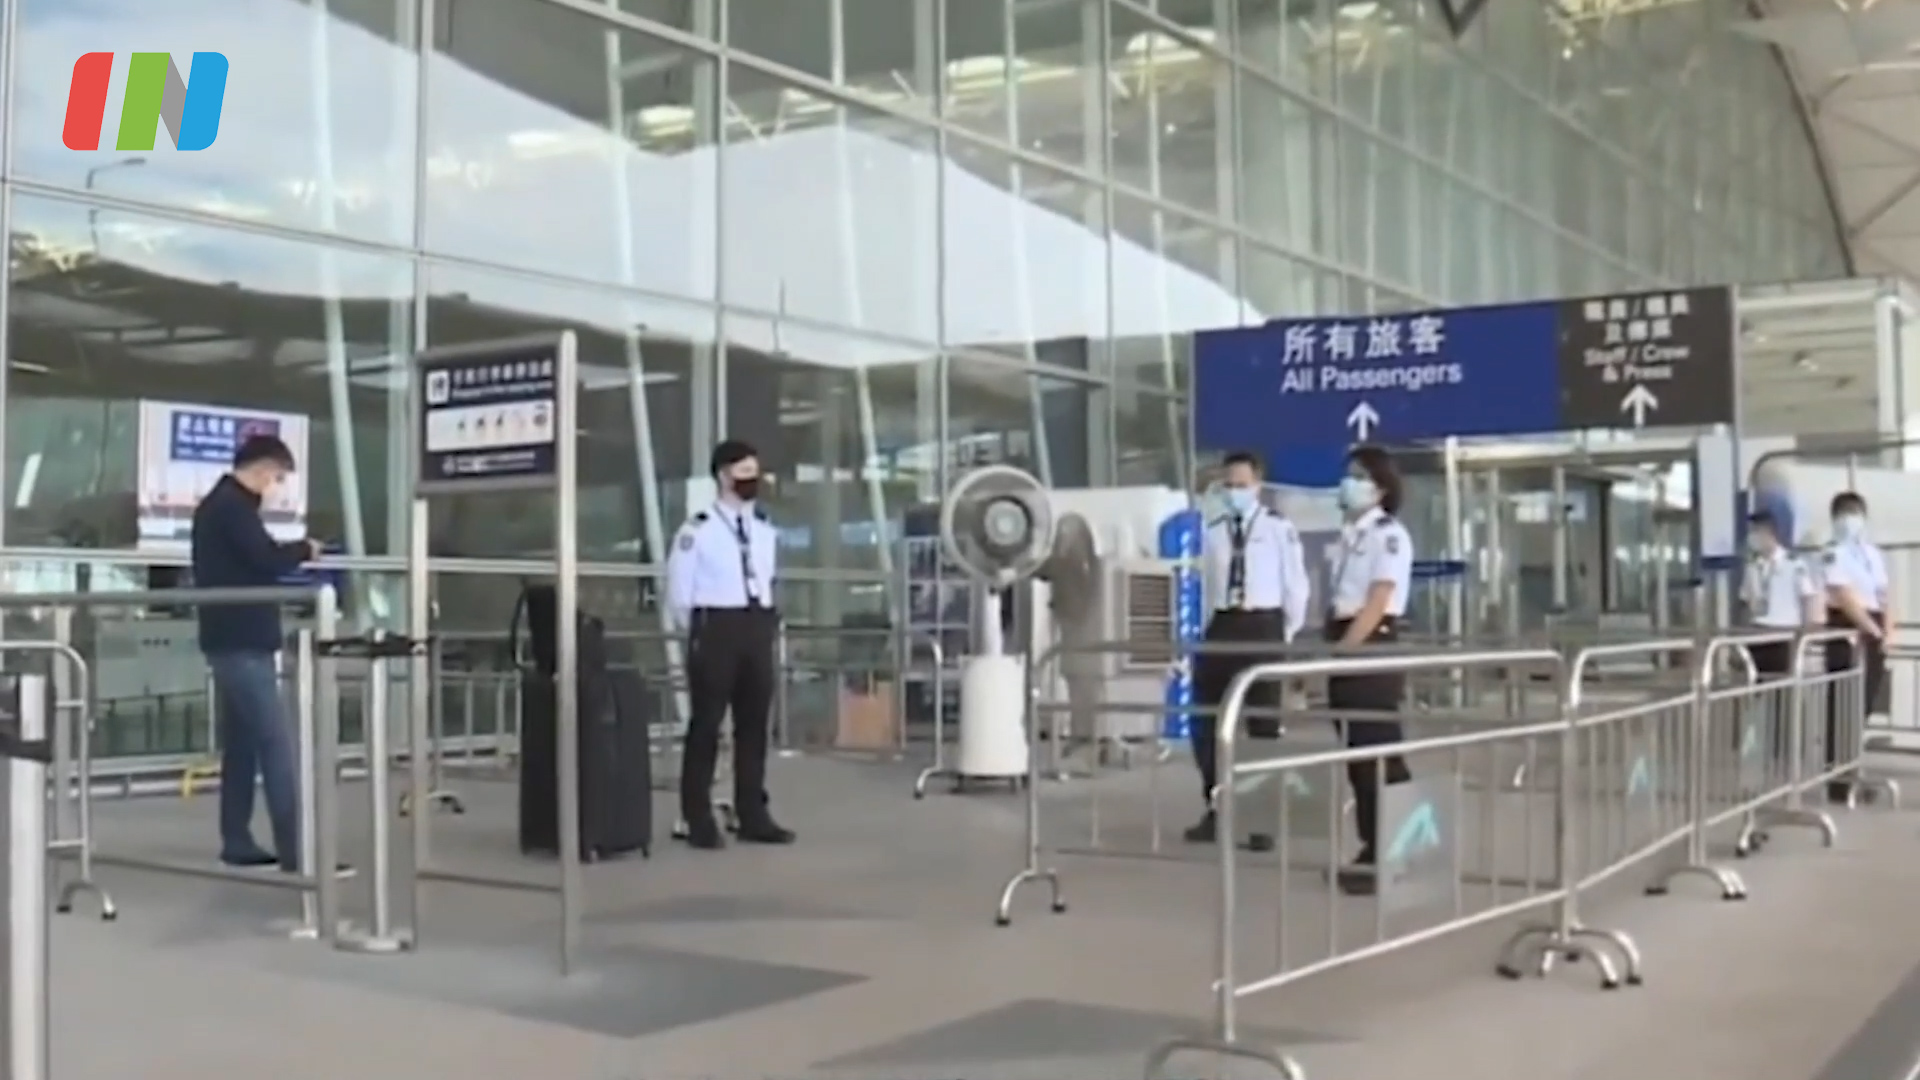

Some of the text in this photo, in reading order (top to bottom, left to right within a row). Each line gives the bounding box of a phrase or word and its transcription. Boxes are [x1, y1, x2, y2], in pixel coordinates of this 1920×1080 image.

[1282, 315, 1446, 365] 所有旅客
[1280, 362, 1463, 394] All Passengers
